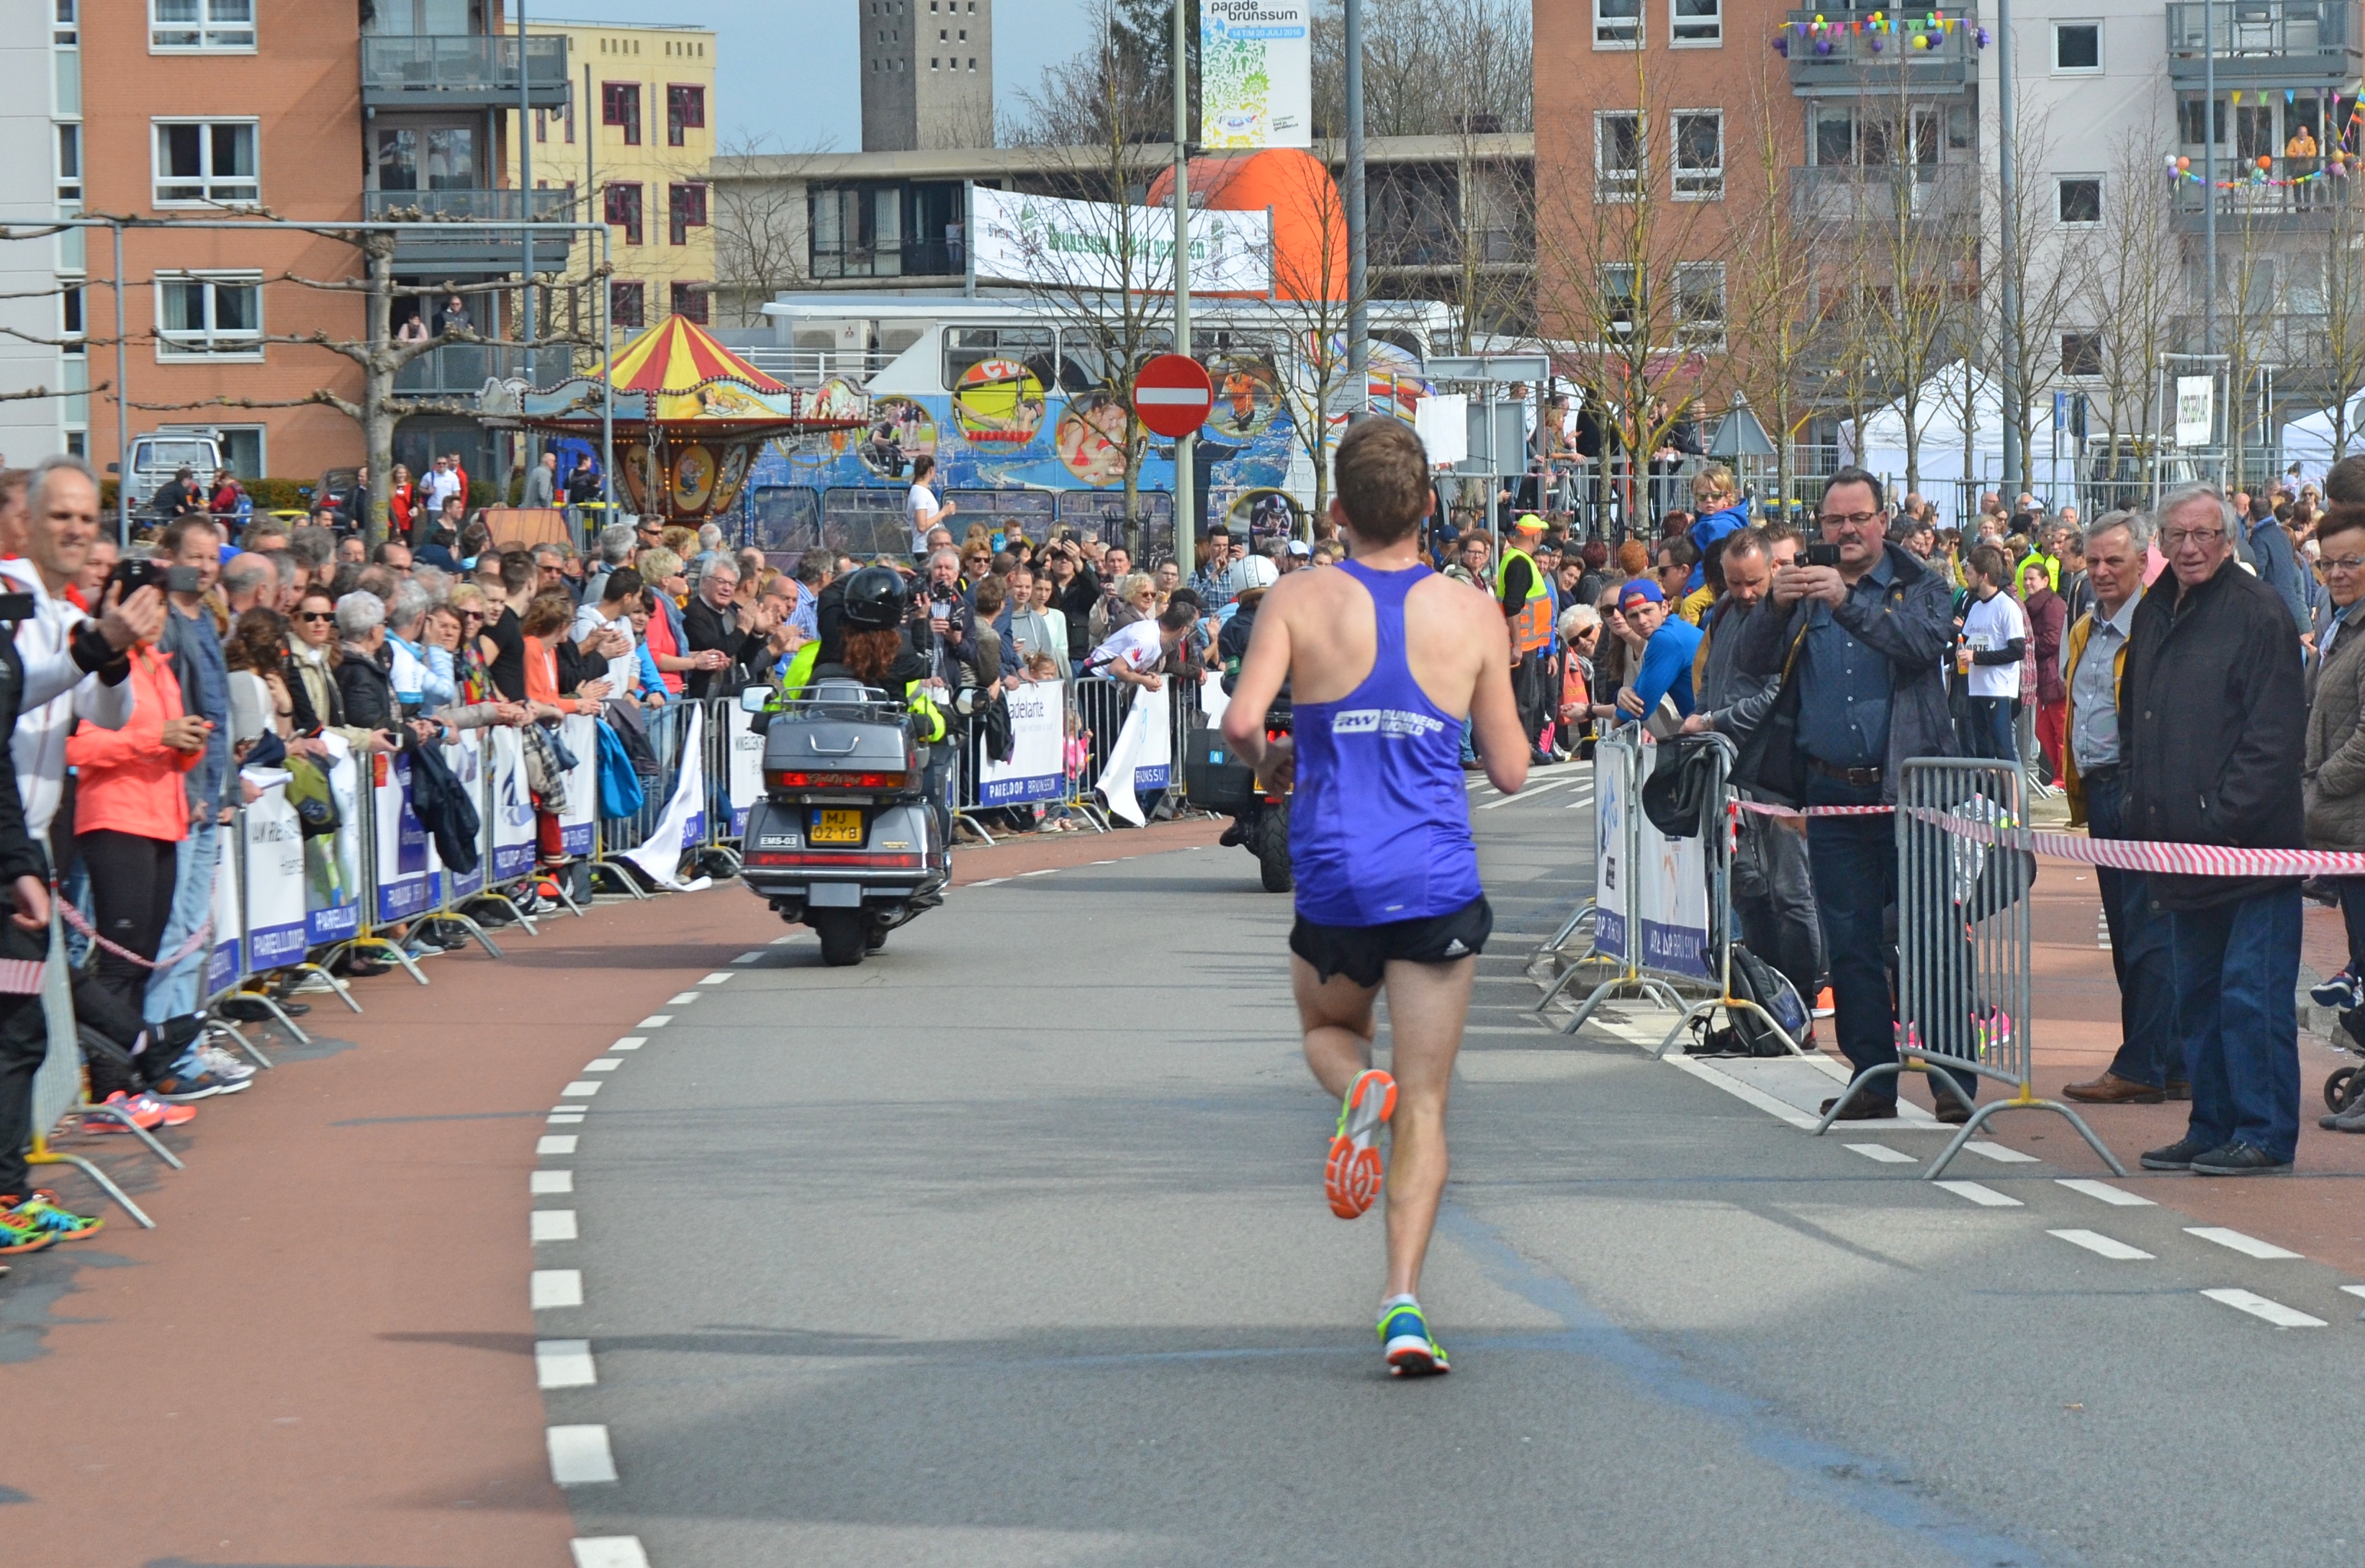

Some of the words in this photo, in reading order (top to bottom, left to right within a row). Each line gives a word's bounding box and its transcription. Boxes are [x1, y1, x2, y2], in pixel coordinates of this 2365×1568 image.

[1212, 0, 1258, 14] parade
[1228, 9, 1298, 21] brunssum
[1009, 697, 1045, 718] adelante
[1382, 708, 1445, 733] RUNNERS
[1381, 720, 1425, 736] WORLD
[826, 812, 846, 824] MJ
[760, 837, 797, 846] EMS-03
